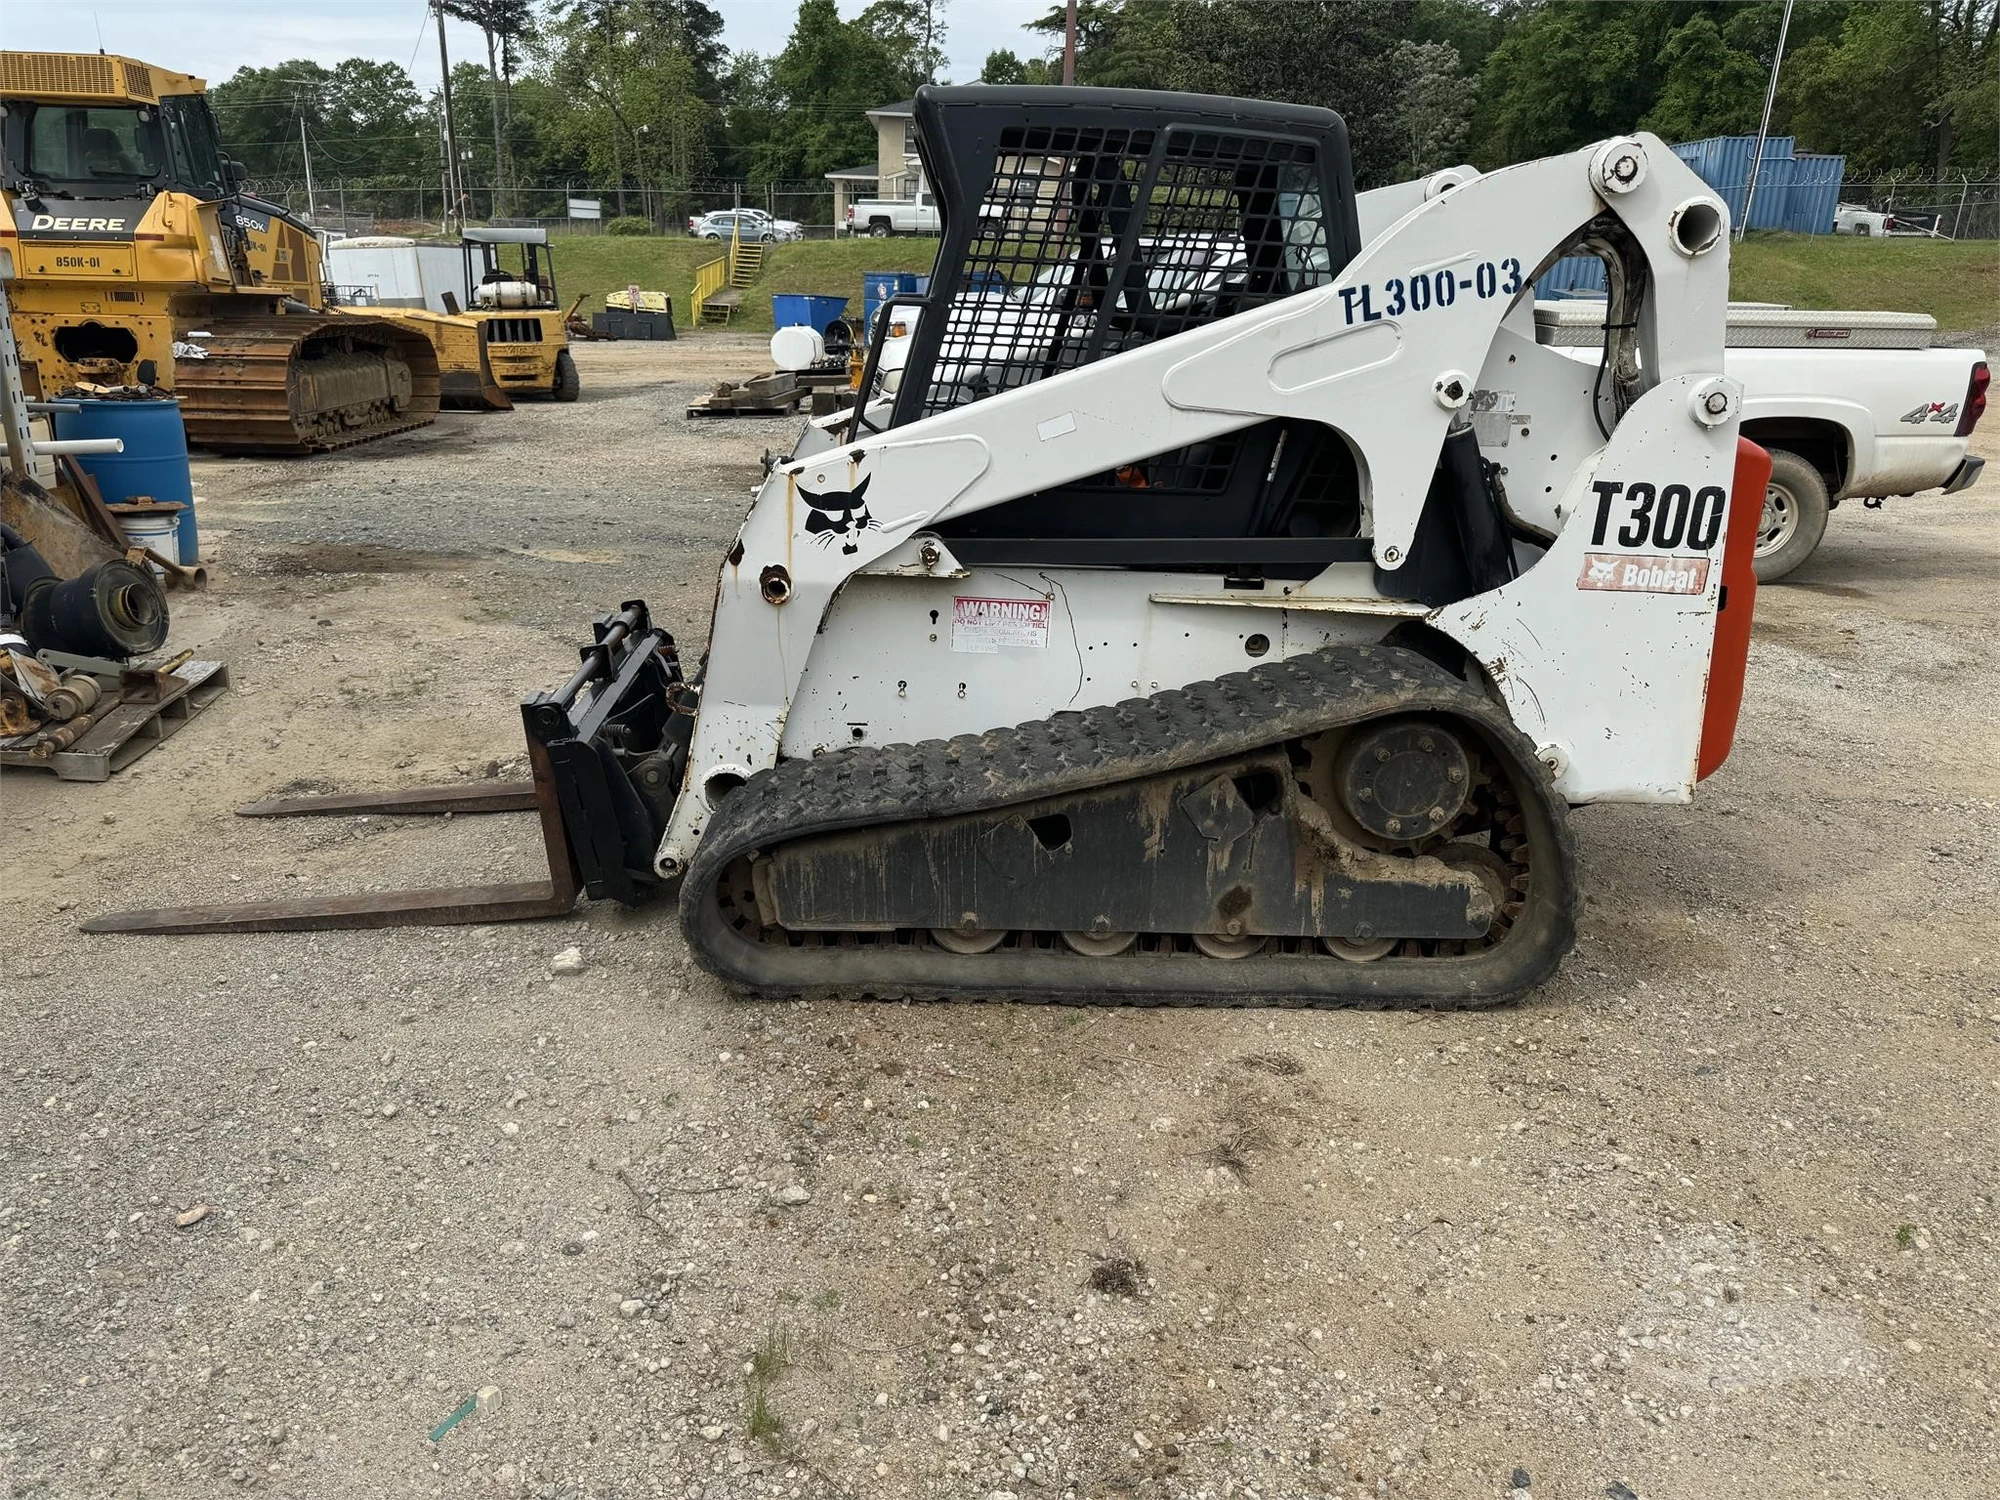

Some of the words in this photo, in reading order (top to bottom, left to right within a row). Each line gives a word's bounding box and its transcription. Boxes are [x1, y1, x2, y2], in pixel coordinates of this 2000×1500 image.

[31, 214, 126, 231] DEERE
[235, 214, 266, 233] 850K
[56, 256, 100, 268] 850K-01
[1338, 258, 1522, 325] TL300-03
[1590, 480, 1727, 551] T300
[1621, 563, 1698, 592] Bobcat
[962, 600, 1041, 621] WARNING
